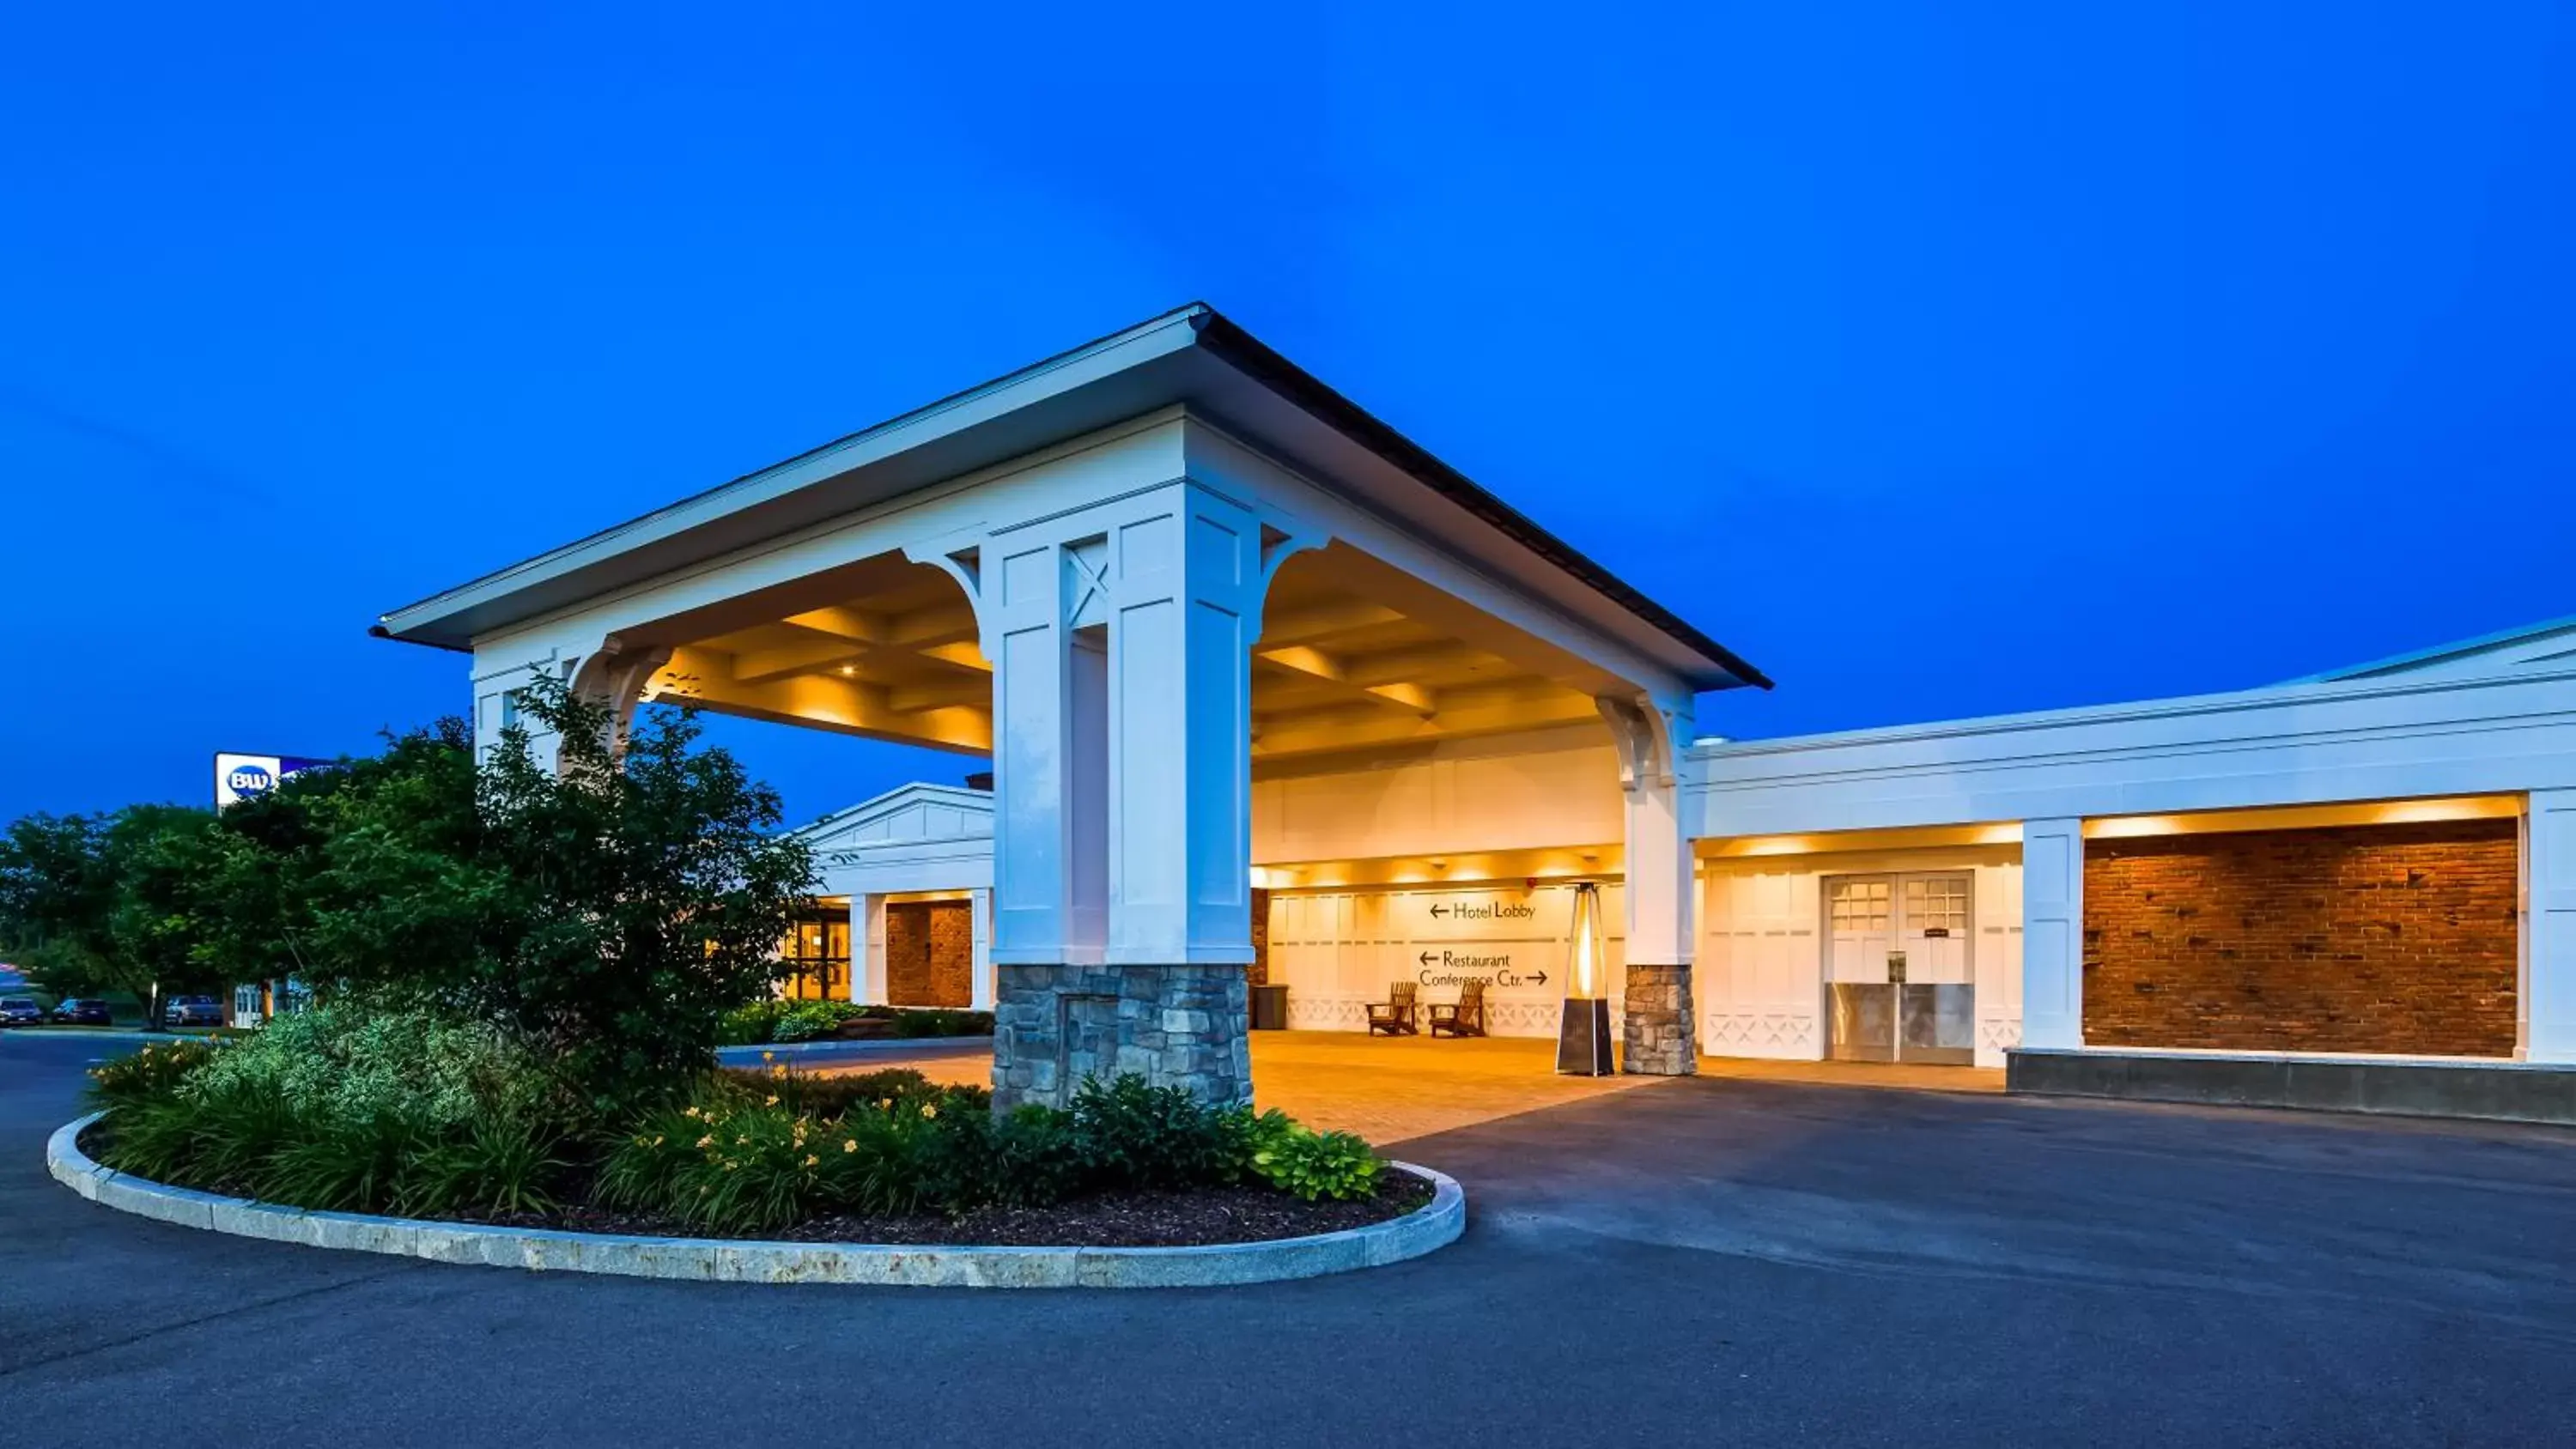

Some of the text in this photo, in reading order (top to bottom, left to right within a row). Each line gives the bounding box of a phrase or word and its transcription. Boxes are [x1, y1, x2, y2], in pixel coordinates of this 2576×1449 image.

[232, 773, 267, 789] BW
[1454, 901, 1535, 920] Hotel Lobby
[1443, 950, 1510, 967] Restaurant
[1497, 970, 1522, 987] Ctr.
